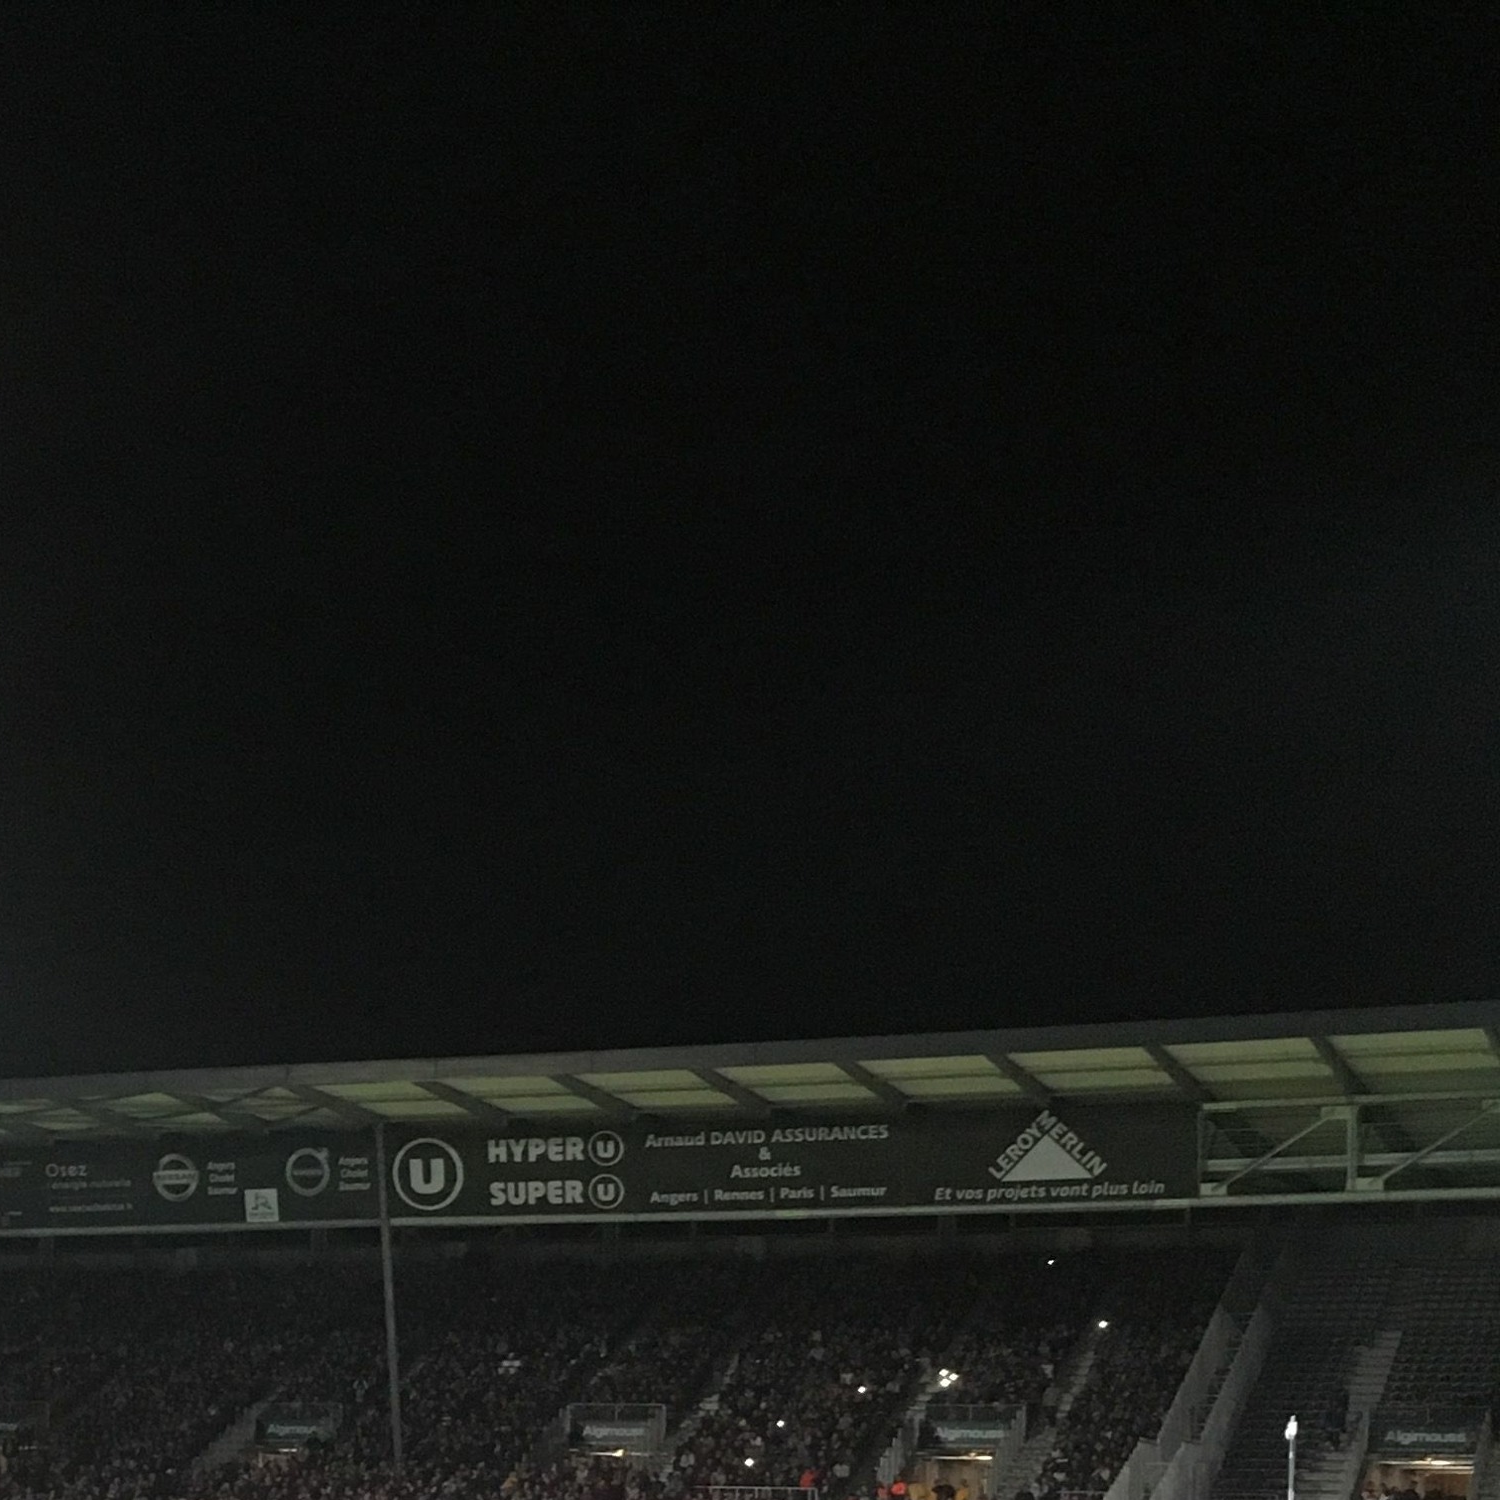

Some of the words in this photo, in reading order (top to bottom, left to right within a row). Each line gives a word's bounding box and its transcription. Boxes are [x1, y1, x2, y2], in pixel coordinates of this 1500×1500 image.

[645, 1132, 706, 1148] Arnaud
[710, 1129, 766, 1145] DAVID
[771, 1124, 889, 1143] ASSURANCES
[988, 1122, 1043, 1180] LEROY
[1036, 1109, 1108, 1177] MERLIN
[487, 1136, 585, 1163] HYPER
[758, 1147, 771, 1160] &
[45, 1163, 88, 1178] Osez
[730, 1162, 801, 1178] Associés
[489, 1180, 584, 1206] SUPER
[650, 1191, 699, 1206] Angers
[714, 1188, 765, 1201] Rennes
[780, 1186, 815, 1199] Paris
[830, 1185, 887, 1197] Saumur
[934, 1187, 953, 1200] Et
[956, 1188, 983, 1200] vos
[986, 1184, 1046, 1202] projets
[1050, 1184, 1088, 1197] vont
[1091, 1181, 1128, 1198] plus
[1132, 1180, 1165, 1194] loin
